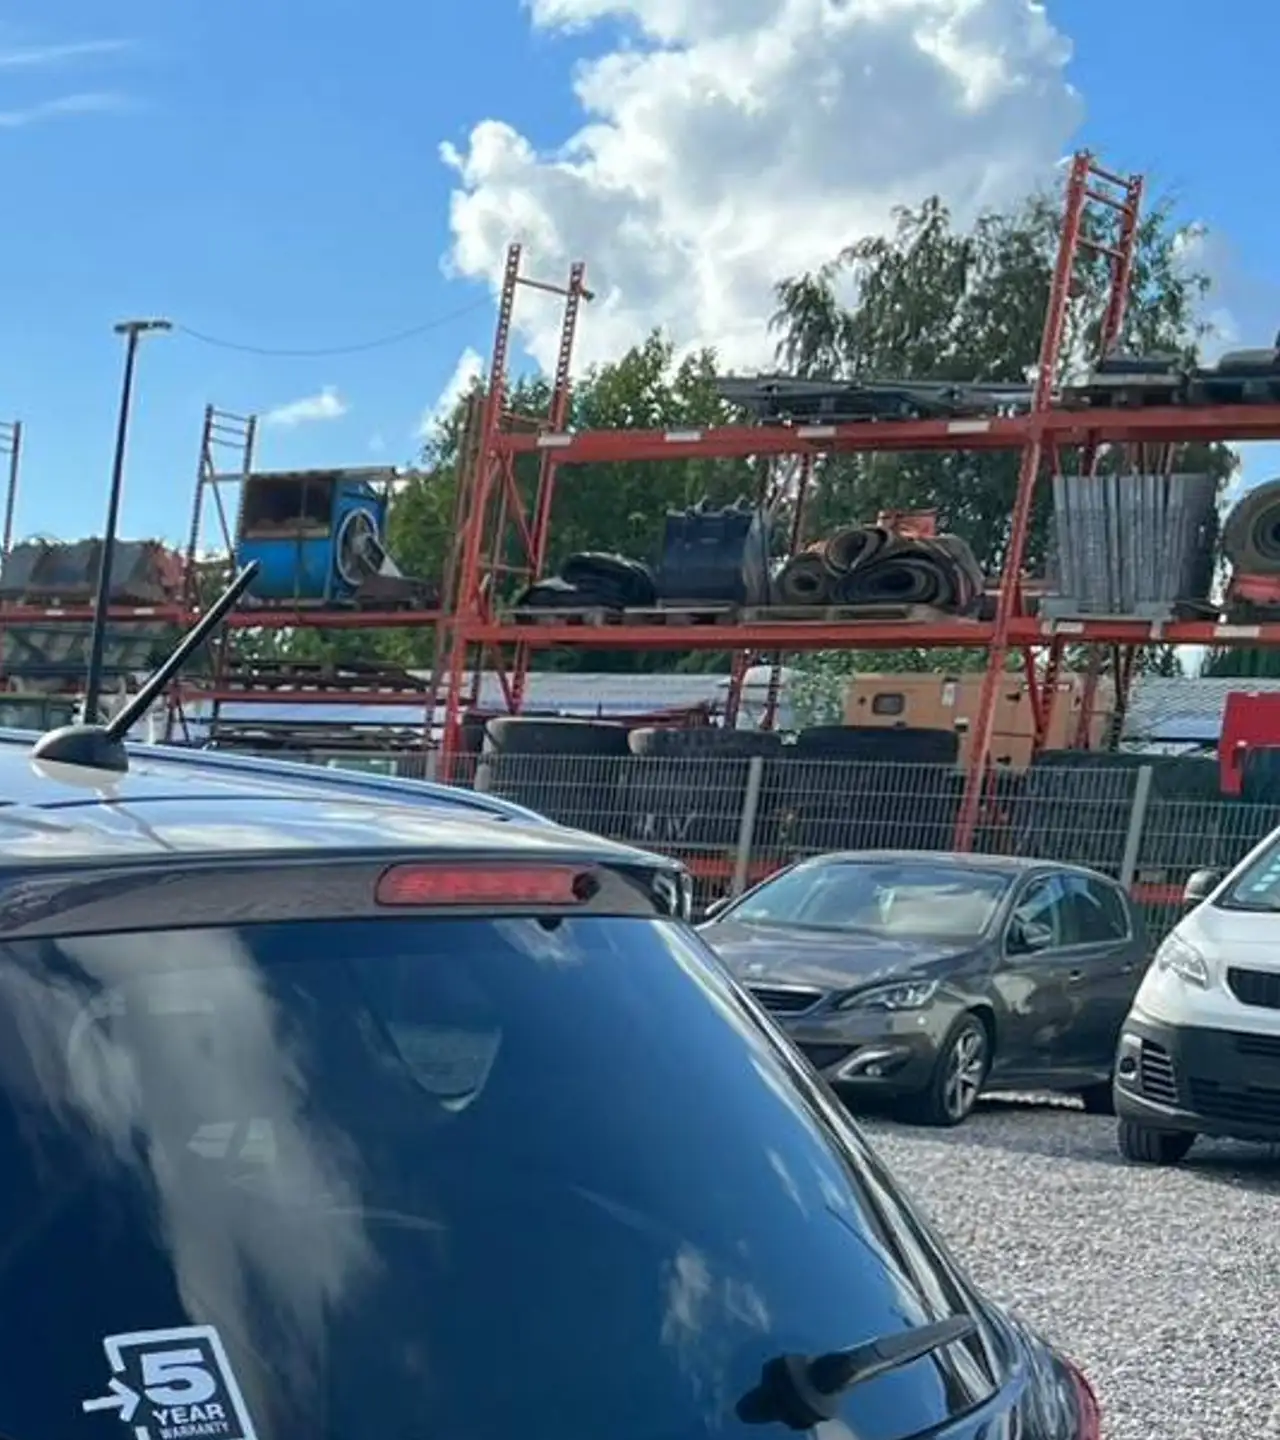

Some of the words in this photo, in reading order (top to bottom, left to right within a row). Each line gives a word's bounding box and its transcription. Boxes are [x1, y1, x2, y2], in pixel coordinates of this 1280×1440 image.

[140, 1348, 216, 1405] 5
[153, 1403, 226, 1425] YEAR
[160, 1421, 229, 1439] WARRANTY
